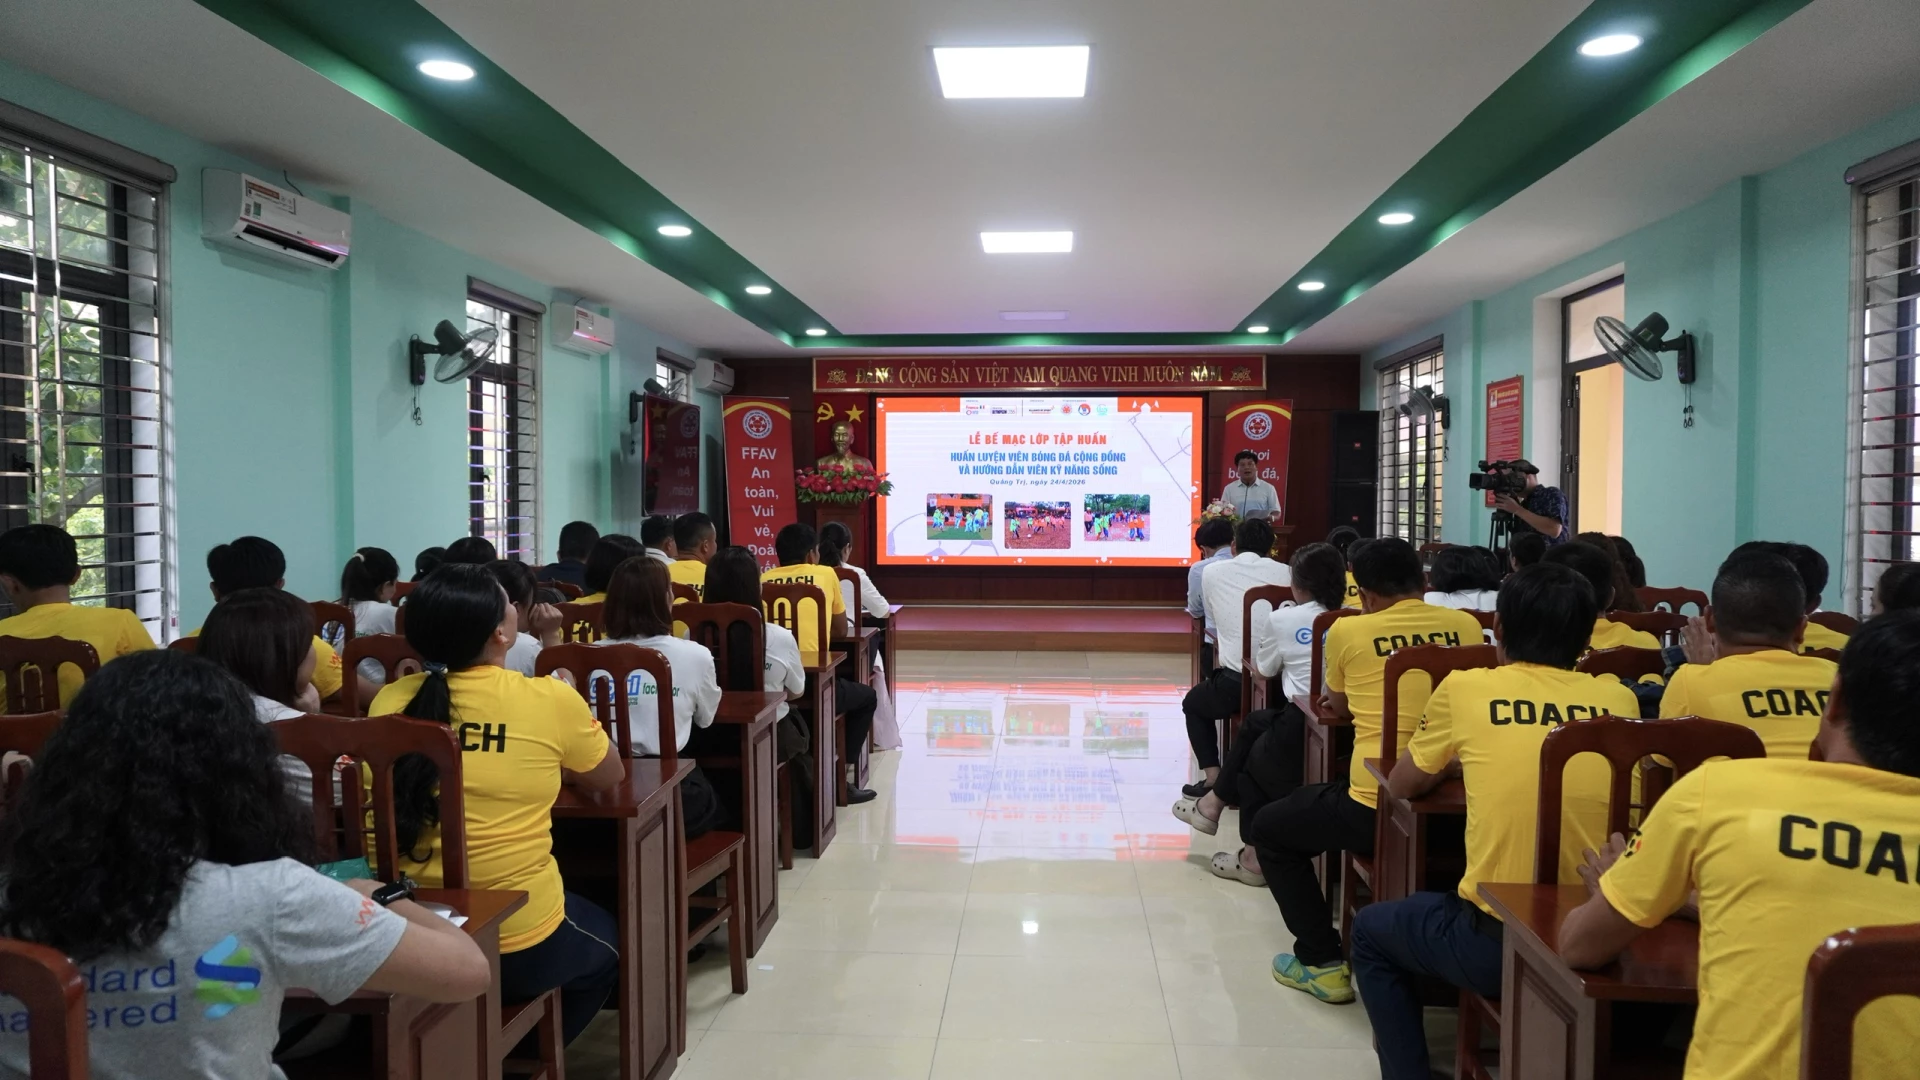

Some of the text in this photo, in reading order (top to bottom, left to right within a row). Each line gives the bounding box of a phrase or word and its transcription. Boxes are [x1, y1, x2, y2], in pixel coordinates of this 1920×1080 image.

[899, 362, 937, 387] CỘNG
[940, 360, 970, 383] SẢN
[975, 362, 1009, 387] VIỆT
[1013, 366, 1046, 383] NAM
[1050, 366, 1098, 386] QUANG
[1101, 366, 1139, 382] VINH
[1143, 360, 1185, 383] MUÔN
[1190, 360, 1223, 382] NĂM
[985, 431, 999, 445] BẾ
[1002, 434, 1026, 447] MẠC
[1030, 432, 1050, 445] LỚP
[1053, 432, 1073, 446] TẬP
[1077, 431, 1107, 445] HUẤN
[741, 447, 777, 460] FFAV
[950, 449, 1126, 464] HUẤN LUYỆN VIÊN BÓNG ĐÁ CỘNG ĐỒNG
[751, 467, 770, 479] An
[959, 462, 1118, 475] VÀ HƯỚNG DẪN VIÊN KỸ NĂNG SỐNG
[1262, 467, 1280, 481] đá,
[989, 478, 1013, 487] Quảng
[744, 486, 779, 499] toàn,
[751, 505, 775, 517] Vui
[754, 524, 775, 538] vẻ,
[747, 543, 778, 556] Đoà
[1778, 814, 1920, 887] COA
